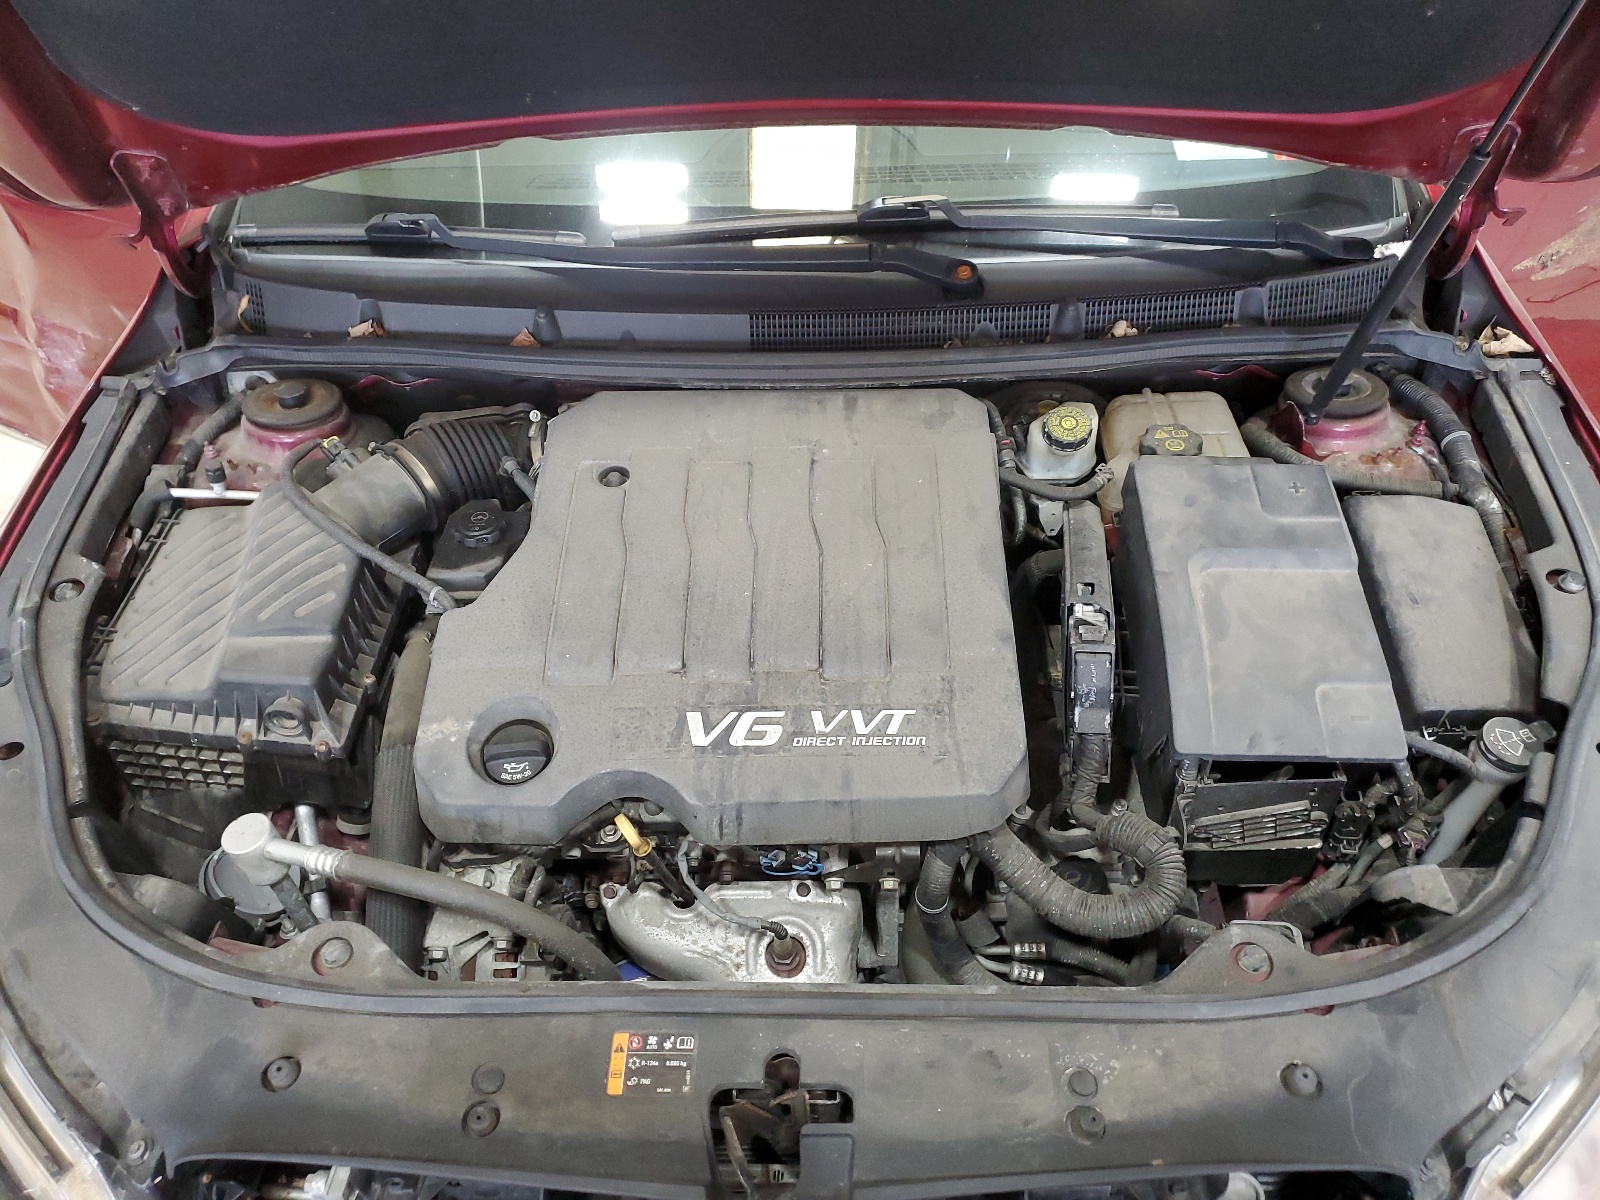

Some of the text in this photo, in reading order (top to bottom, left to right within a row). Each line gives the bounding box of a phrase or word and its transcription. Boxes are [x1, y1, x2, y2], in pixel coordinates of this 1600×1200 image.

[685, 709, 917, 747] V6 VVT
[792, 736, 927, 747] DIRECT INJECTION
[501, 770, 532, 780] SAE 5W-30
